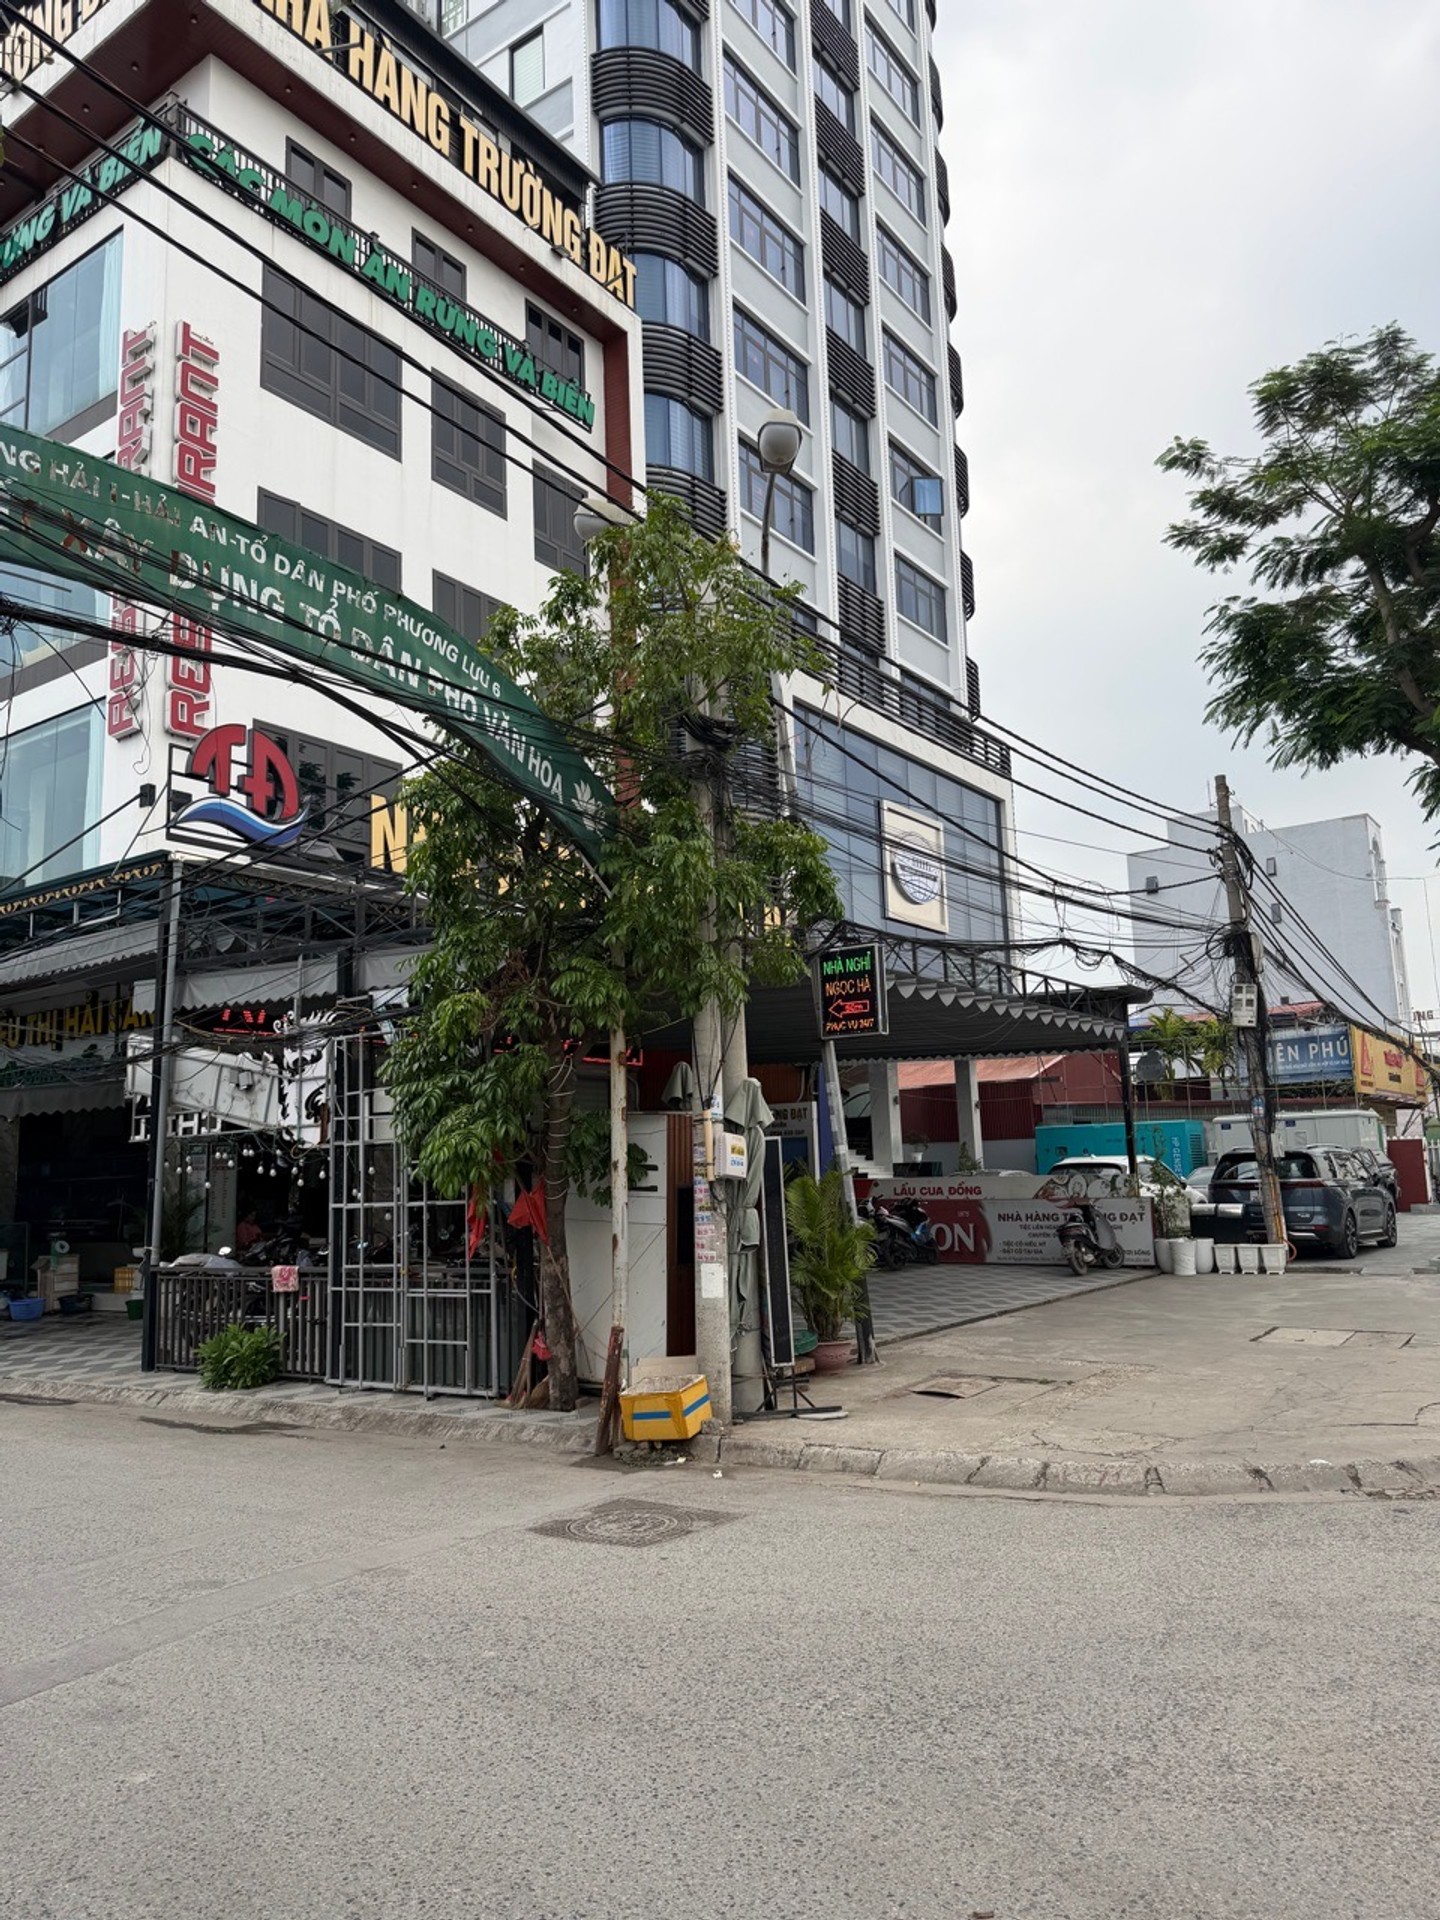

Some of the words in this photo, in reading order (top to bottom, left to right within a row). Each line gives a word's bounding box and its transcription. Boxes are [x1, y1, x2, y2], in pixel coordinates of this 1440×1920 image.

[348, 19, 450, 158] HÀNG
[458, 111, 581, 266] TRƯỜNG
[588, 229, 637, 309] ĐẠT
[184, 133, 265, 192] CÁC
[269, 187, 358, 265] MÓN
[361, 242, 411, 301] ĂN
[415, 287, 498, 358] RỪNG
[502, 343, 537, 389] VÀ
[540, 371, 596, 427] BIỂN
[168, 549, 286, 624] DỰNG
[298, 597, 342, 649] TỔ
[350, 627, 422, 690] DÂN
[274, 552, 326, 593] DÂN
[331, 579, 380, 615] PHỐ
[383, 603, 460, 664] PHƯƠNG
[461, 654, 491, 691] LƯU
[491, 682, 502, 699] 6
[822, 955, 845, 977] NHÀ
[845, 951, 872, 973] NGHỈ
[824, 979, 855, 997] NGỌC
[26, 1009, 58, 1051] THỊ
[65, 990, 103, 1041] HẢI
[1308, 1035, 1349, 1060] PHÚ
[919, 1186, 944, 1196] CUA
[997, 1210, 1023, 1222] NHÀ
[1025, 1210, 1060, 1222] HÀNG
[1119, 1211, 1146, 1225] ĐẠT
